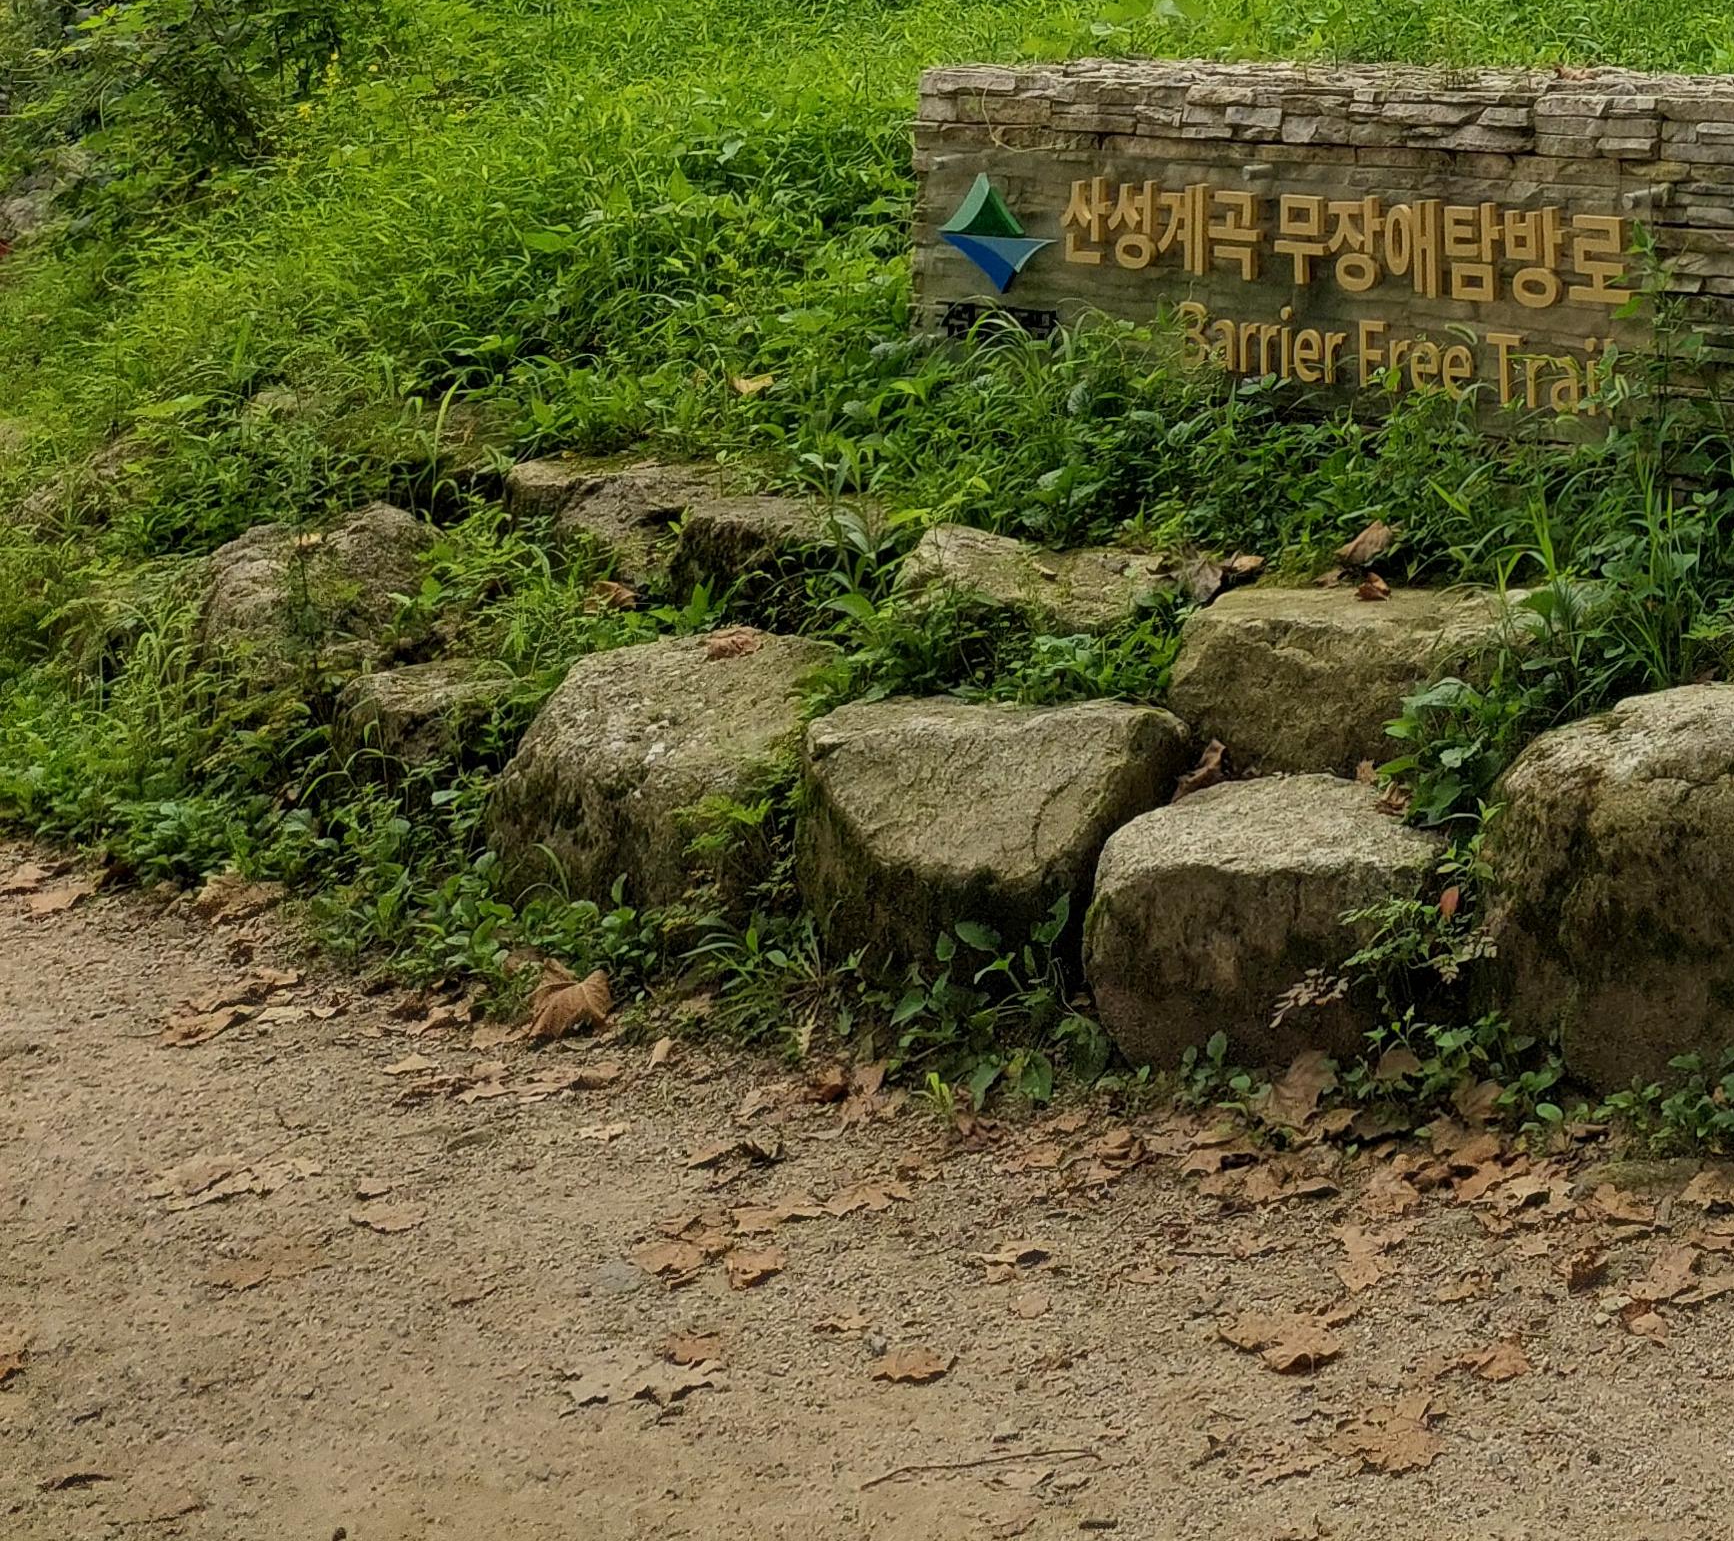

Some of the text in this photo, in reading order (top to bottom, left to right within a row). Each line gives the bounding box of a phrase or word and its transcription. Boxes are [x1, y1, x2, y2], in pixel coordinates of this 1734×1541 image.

[1062, 177, 1637, 310] 산성계곡 무장애탐방로
[1180, 300, 1615, 419] Barrier Free Trai
